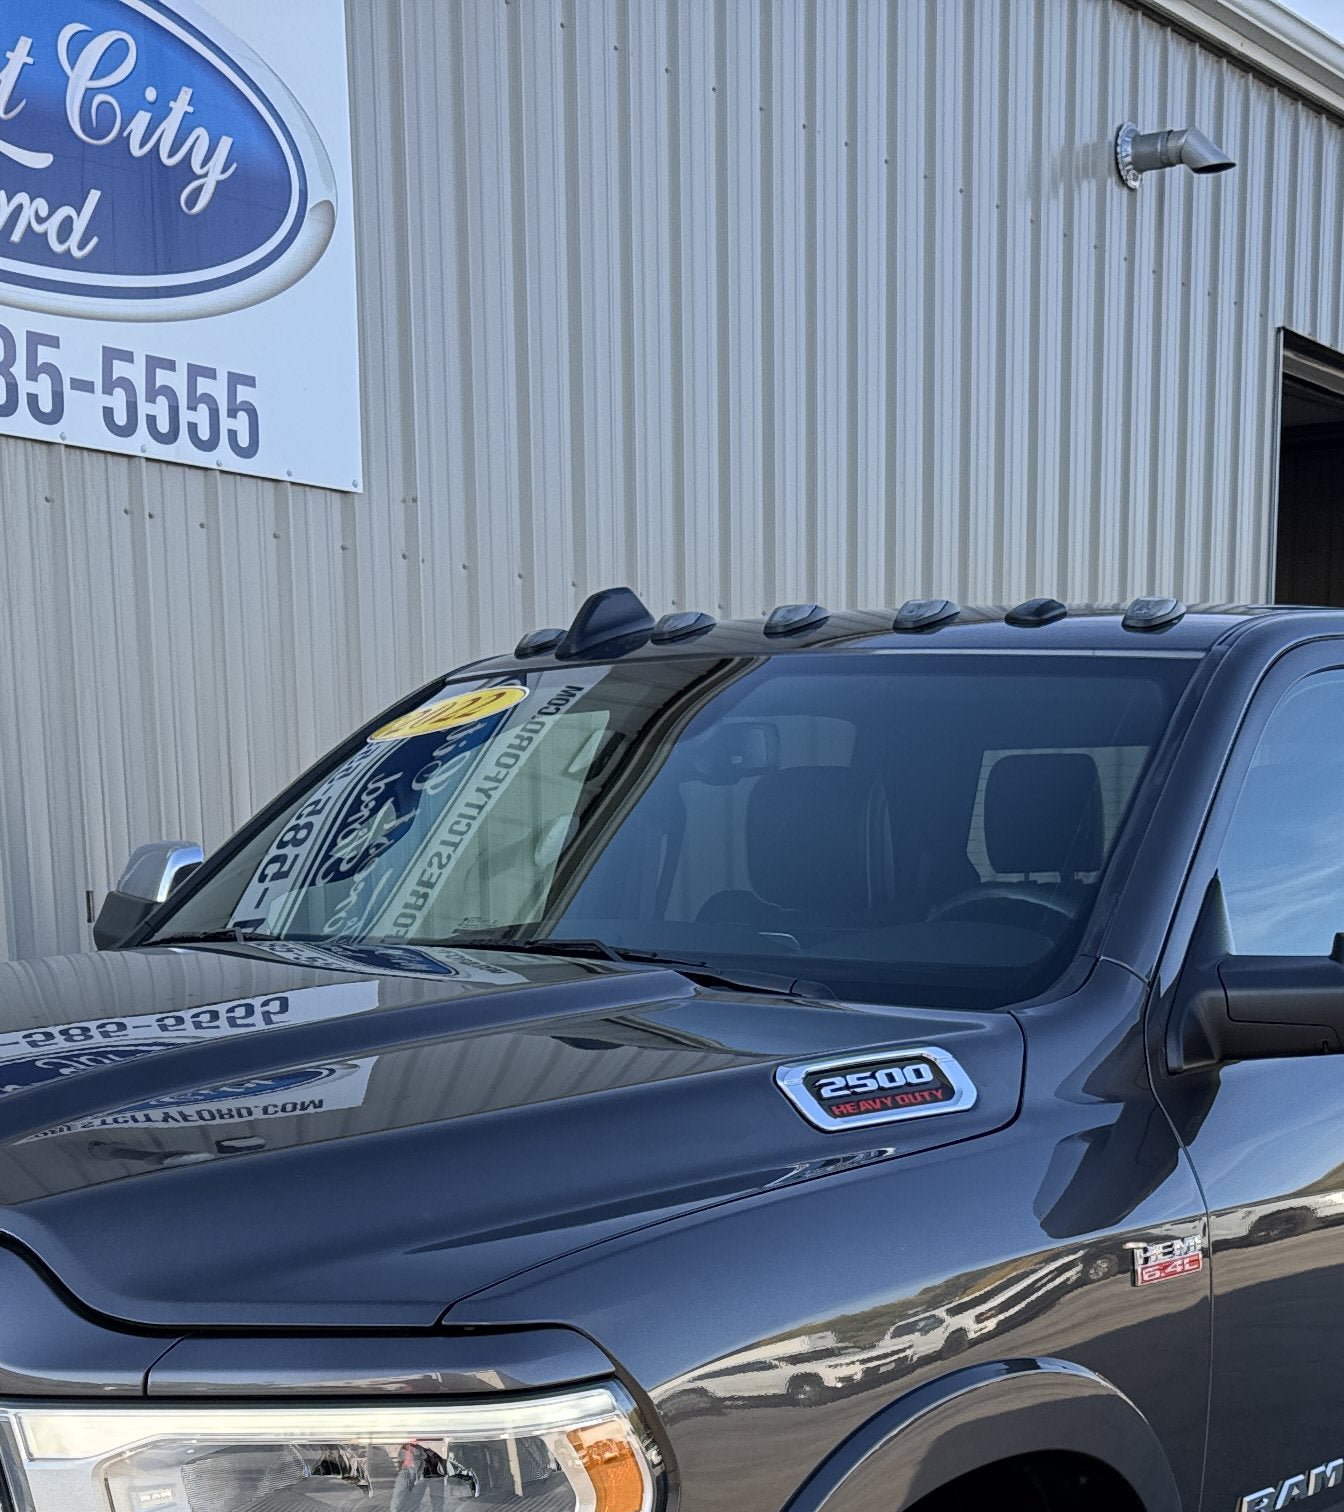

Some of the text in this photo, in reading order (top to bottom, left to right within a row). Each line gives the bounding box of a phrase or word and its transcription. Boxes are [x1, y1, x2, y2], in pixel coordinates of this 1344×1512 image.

[57, 22, 238, 216] City
[813, 1063, 934, 1098] 2500
[831, 1089, 944, 1116] HEAVY DUTY
[1142, 1256, 1199, 1281] 6.4L
